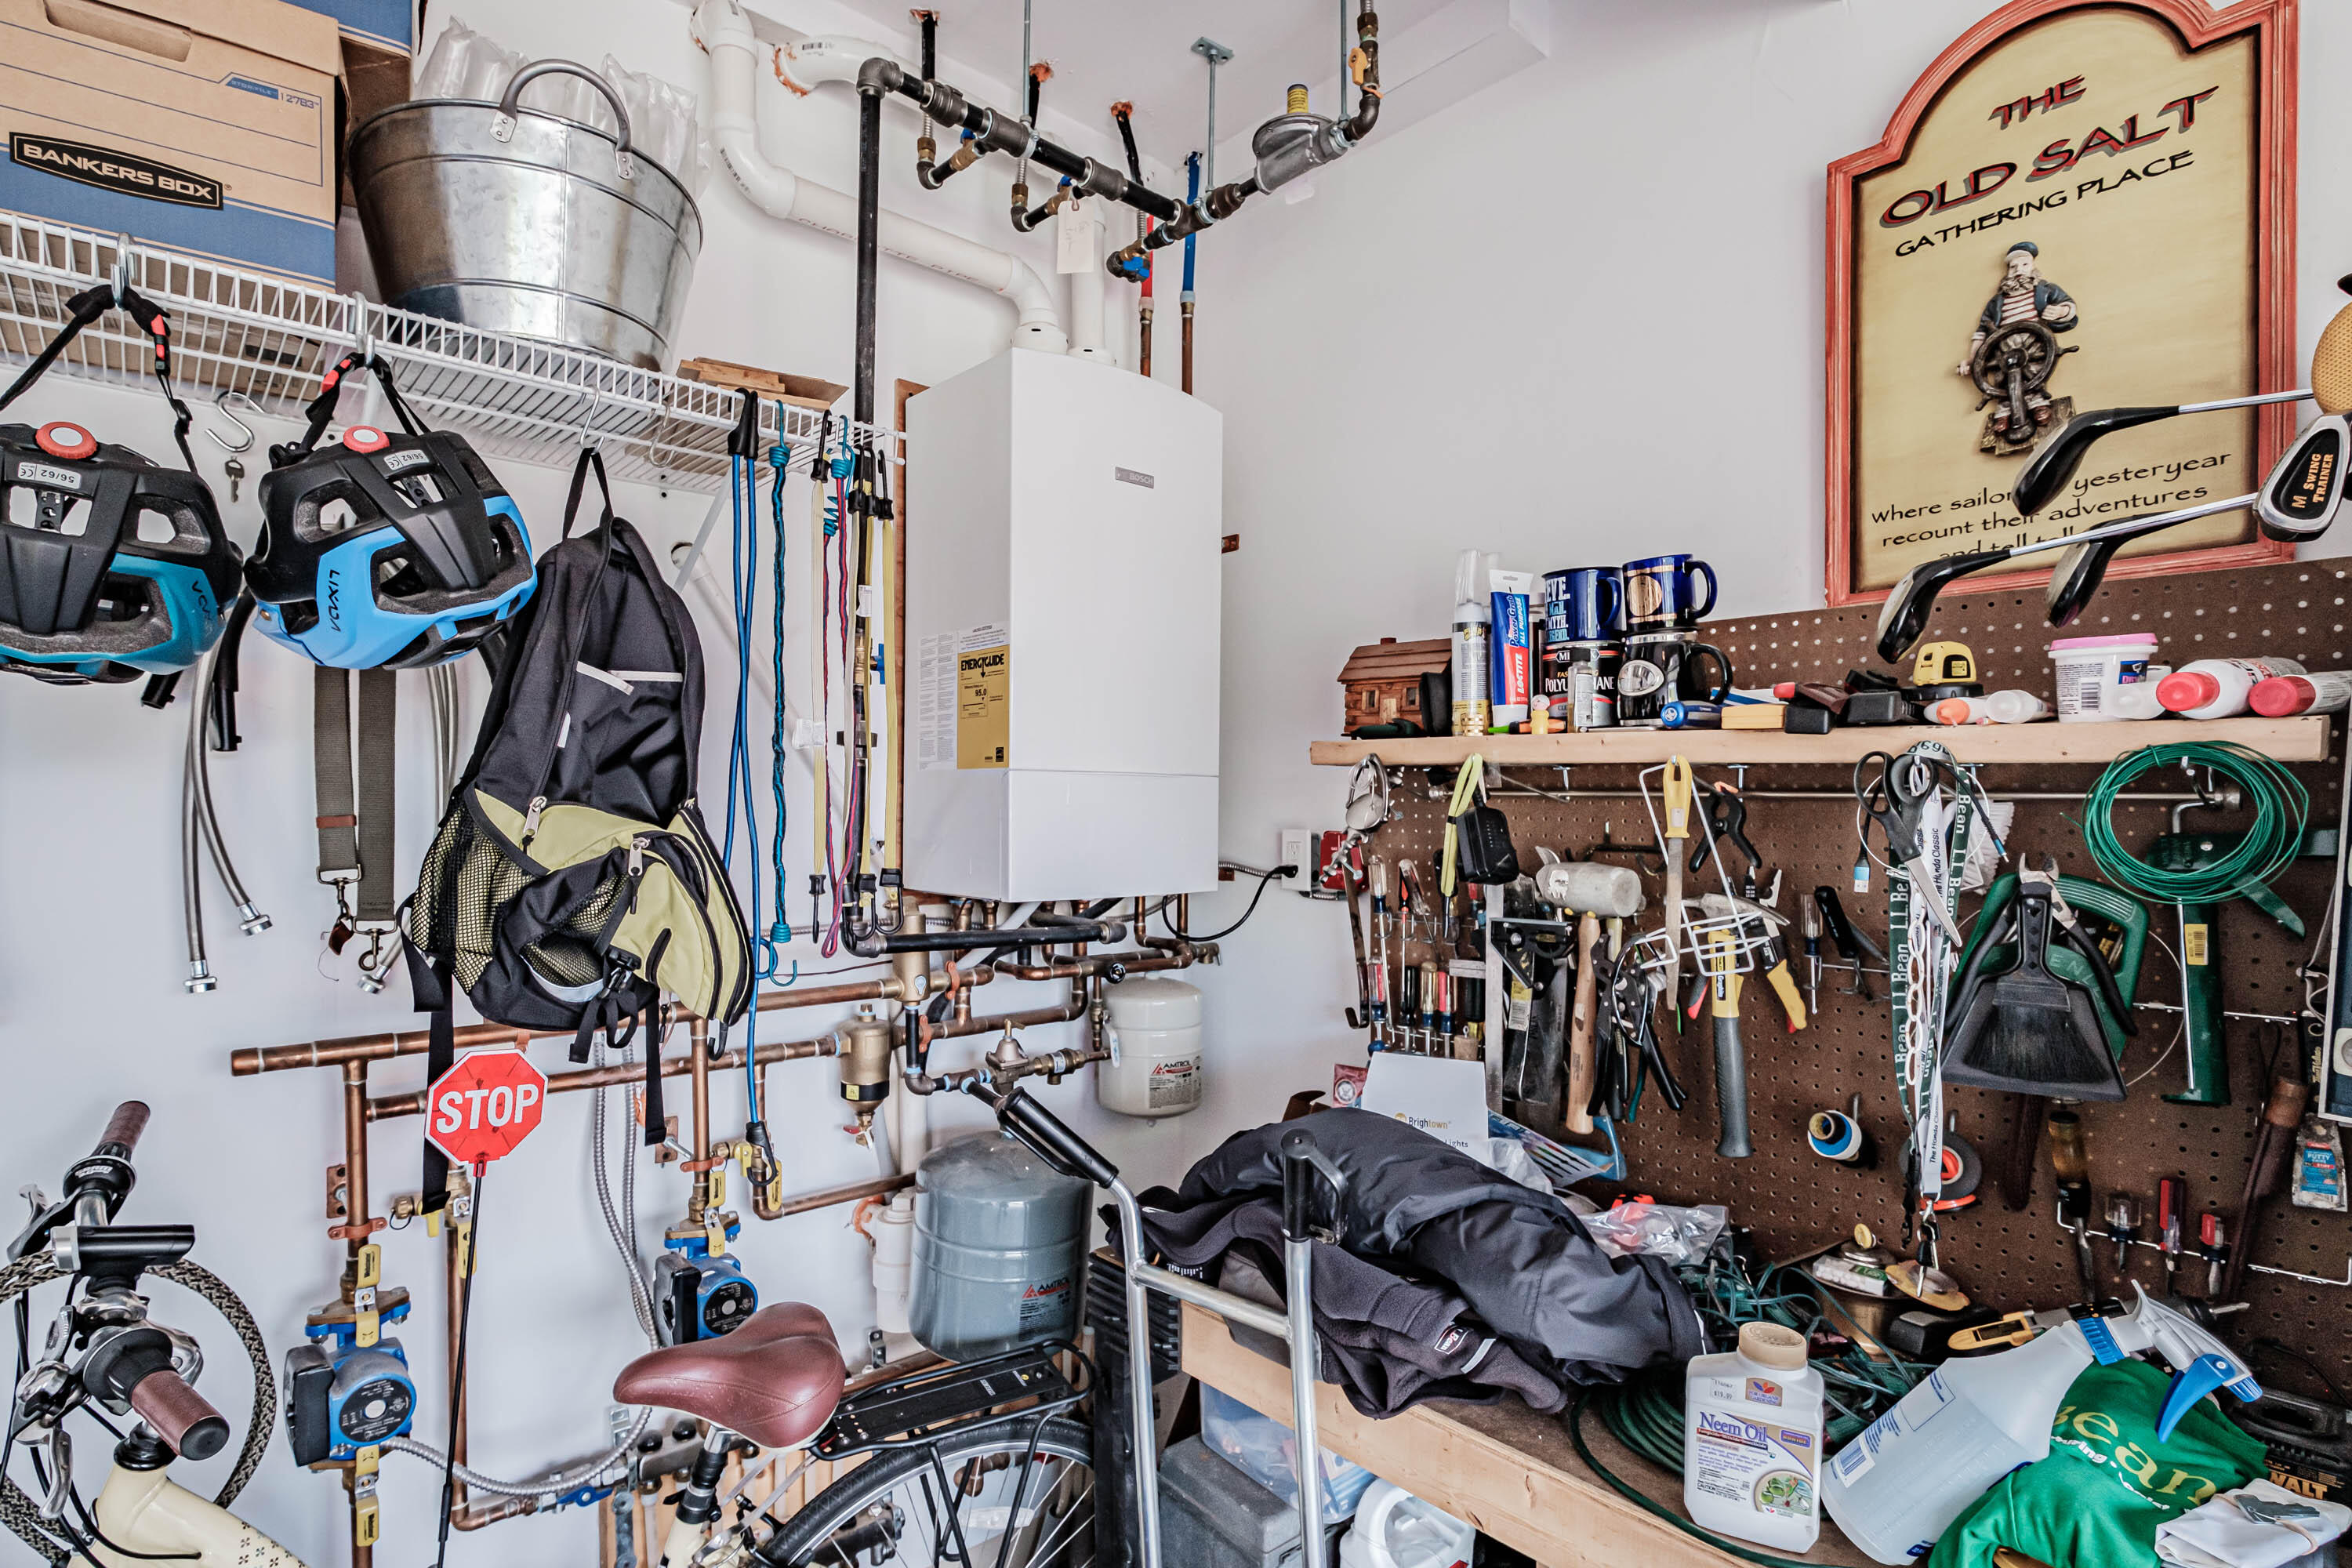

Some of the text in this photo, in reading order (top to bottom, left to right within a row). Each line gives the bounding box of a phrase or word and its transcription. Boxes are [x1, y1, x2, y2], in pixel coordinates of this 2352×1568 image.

[1990, 74, 2087, 128] THE
[23, 143, 213, 199] BANKERS BOX
[1880, 85, 2220, 228] OLD SALT
[1895, 149, 2194, 257] GATHERING PLACE
[40, 469, 75, 484] 56/62
[1129, 472, 1153, 485] BOSCH
[1871, 453, 2232, 524] where sailor yesteryear
[2303, 453, 2321, 490] SWING
[2312, 454, 2334, 503] TRAINER
[1882, 521, 1973, 547] recount
[2048, 486, 2209, 521] adventures
[2291, 495, 2307, 509] M
[1515, 596, 1524, 630] PURPOSE
[1509, 618, 1519, 648] Power
[1515, 652, 1524, 694] LOCTITE
[1933, 858, 1943, 884] Hnda
[1163, 1060, 1191, 1069] AMTROL
[436, 1083, 539, 1134] STOP
[1408, 1116, 1449, 1129] Brightown
[1700, 1411, 1768, 1443] Neem Oil
